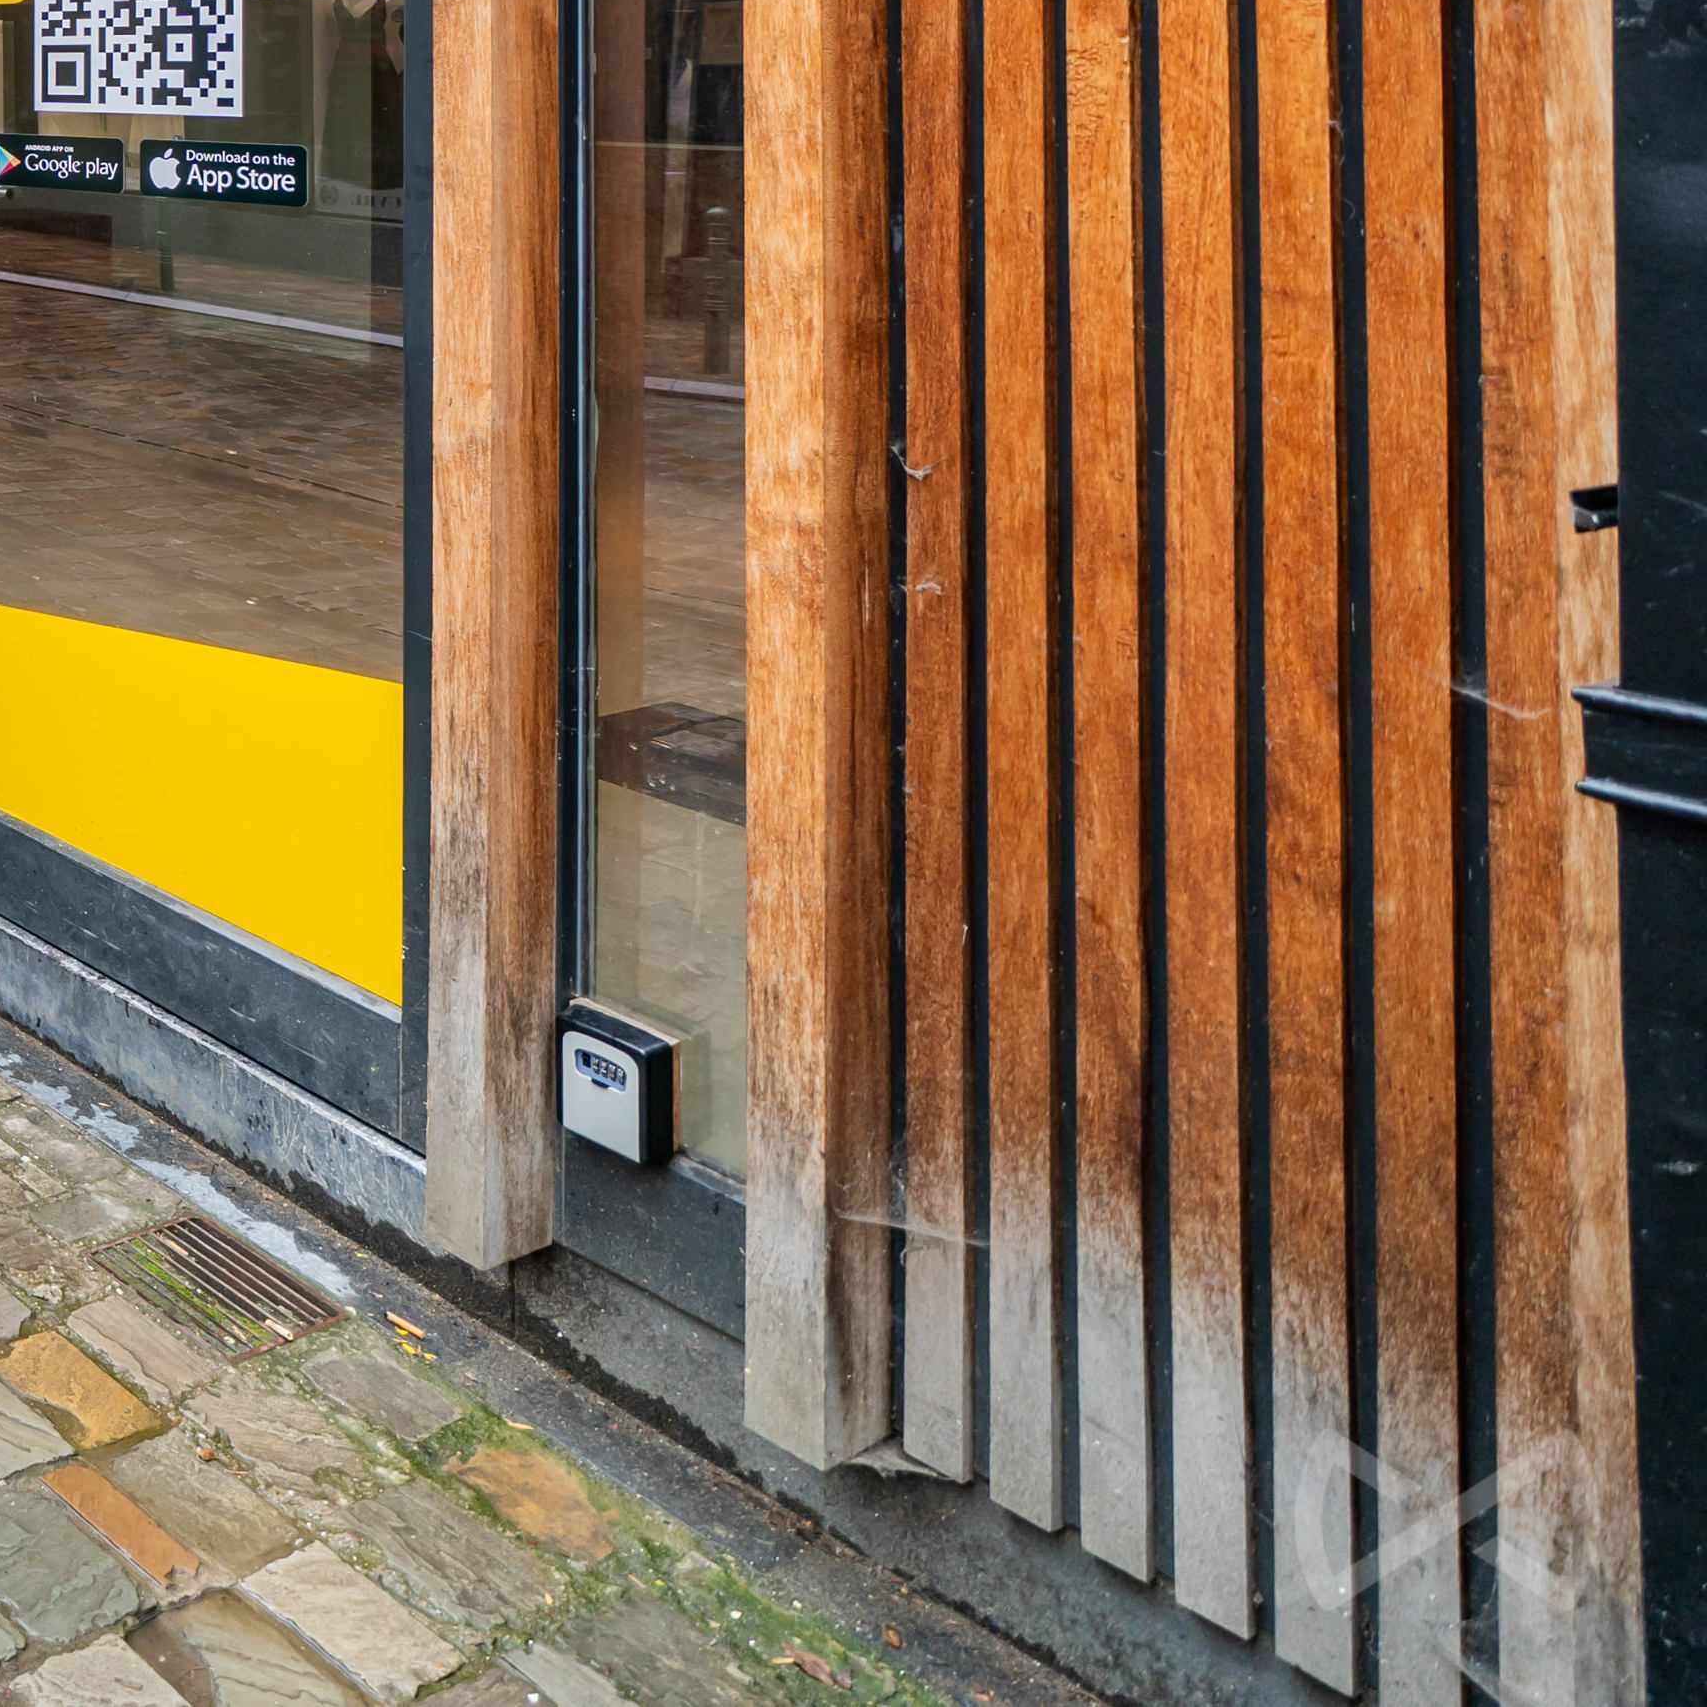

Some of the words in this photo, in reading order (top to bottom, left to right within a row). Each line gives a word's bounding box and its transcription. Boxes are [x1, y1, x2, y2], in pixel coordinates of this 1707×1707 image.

[25, 144, 50, 152] ANDROID
[186, 149, 249, 164] Download
[254, 153, 270, 165] on
[273, 153, 295, 166] the
[25, 153, 81, 178] Google
[86, 158, 118, 180] play
[187, 163, 233, 192] App
[236, 166, 296, 192] Store
